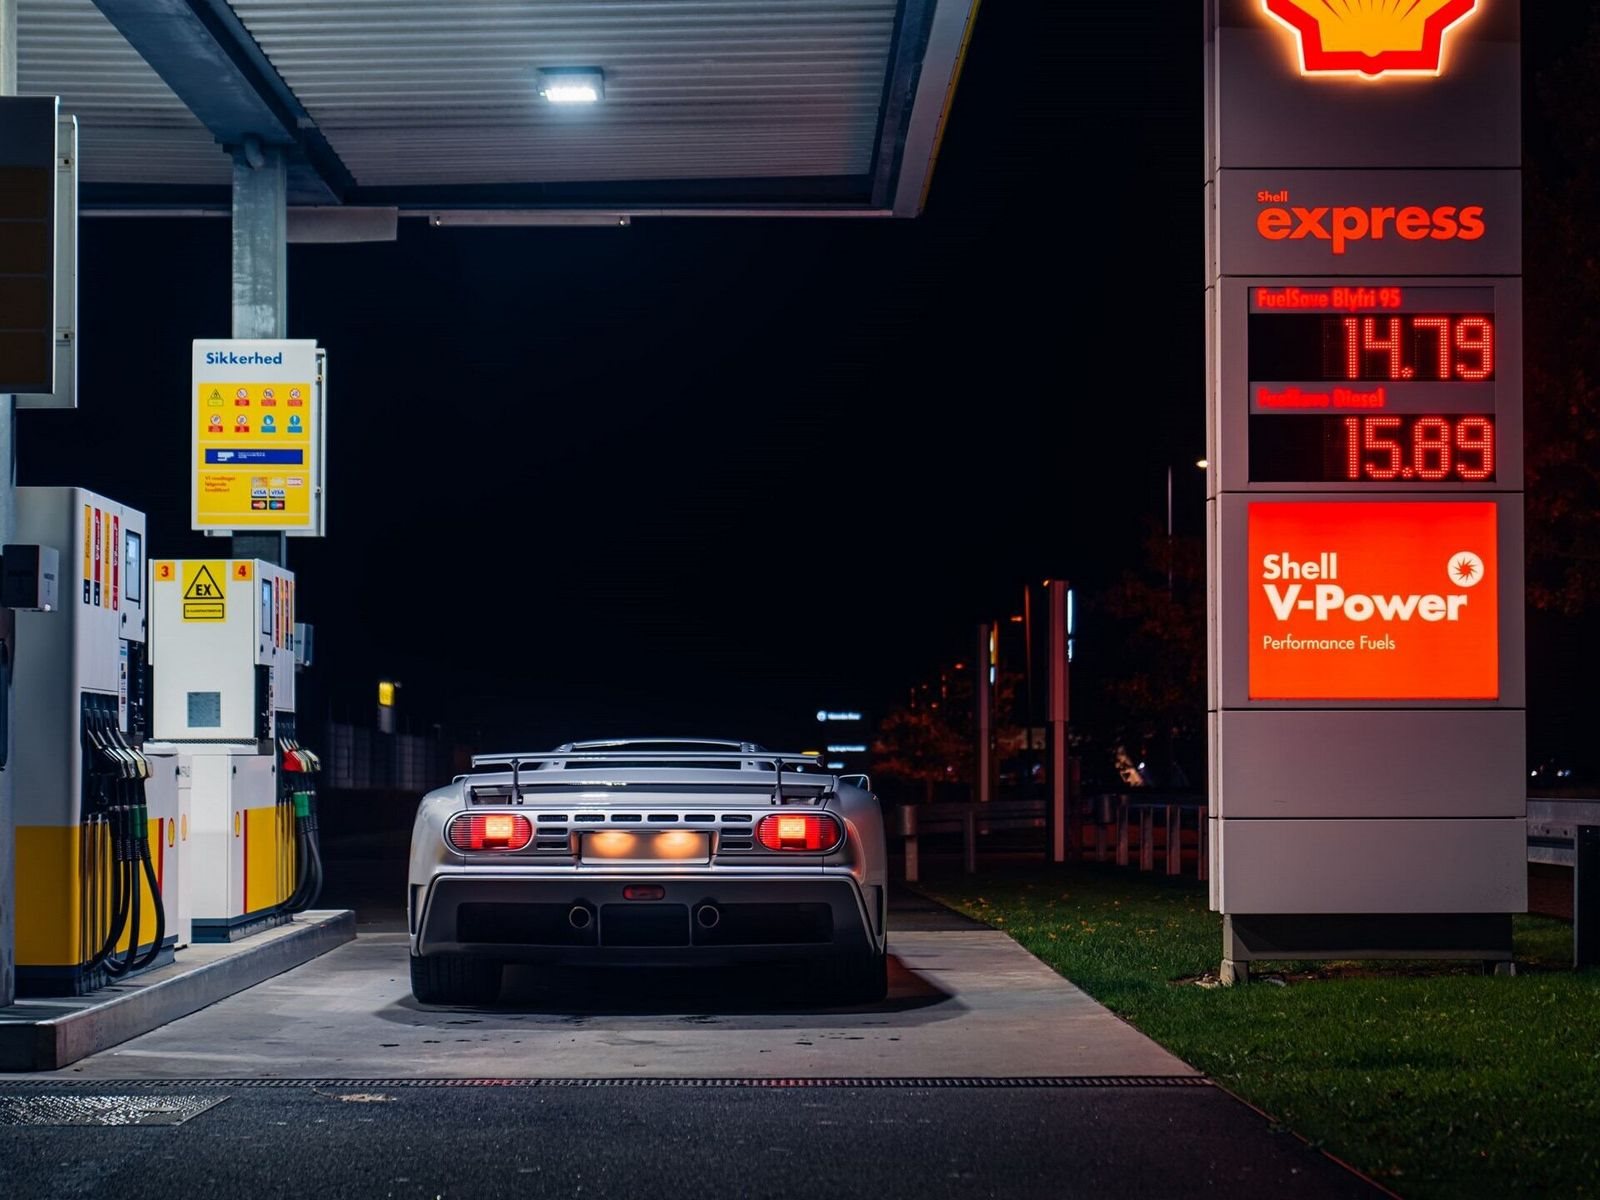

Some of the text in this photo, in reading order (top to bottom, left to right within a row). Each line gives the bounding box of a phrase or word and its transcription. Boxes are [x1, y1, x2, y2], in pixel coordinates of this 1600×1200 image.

[1257, 190, 1288, 202] Shell
[1256, 206, 1485, 254] express
[1257, 287, 1401, 312] FuelSave Blyfri 95
[206, 351, 282, 365] Sikkerhed
[1345, 318, 1492, 379] 14.79
[1333, 386, 1385, 408] Diesel
[1346, 418, 1493, 478] 15.89
[161, 565, 169, 577] 3
[237, 565, 246, 577] 4
[1262, 552, 1337, 580] Shell
[195, 583, 212, 596] EX
[1262, 584, 1467, 622] V-Power
[1263, 633, 1396, 650] Performance Fuels
